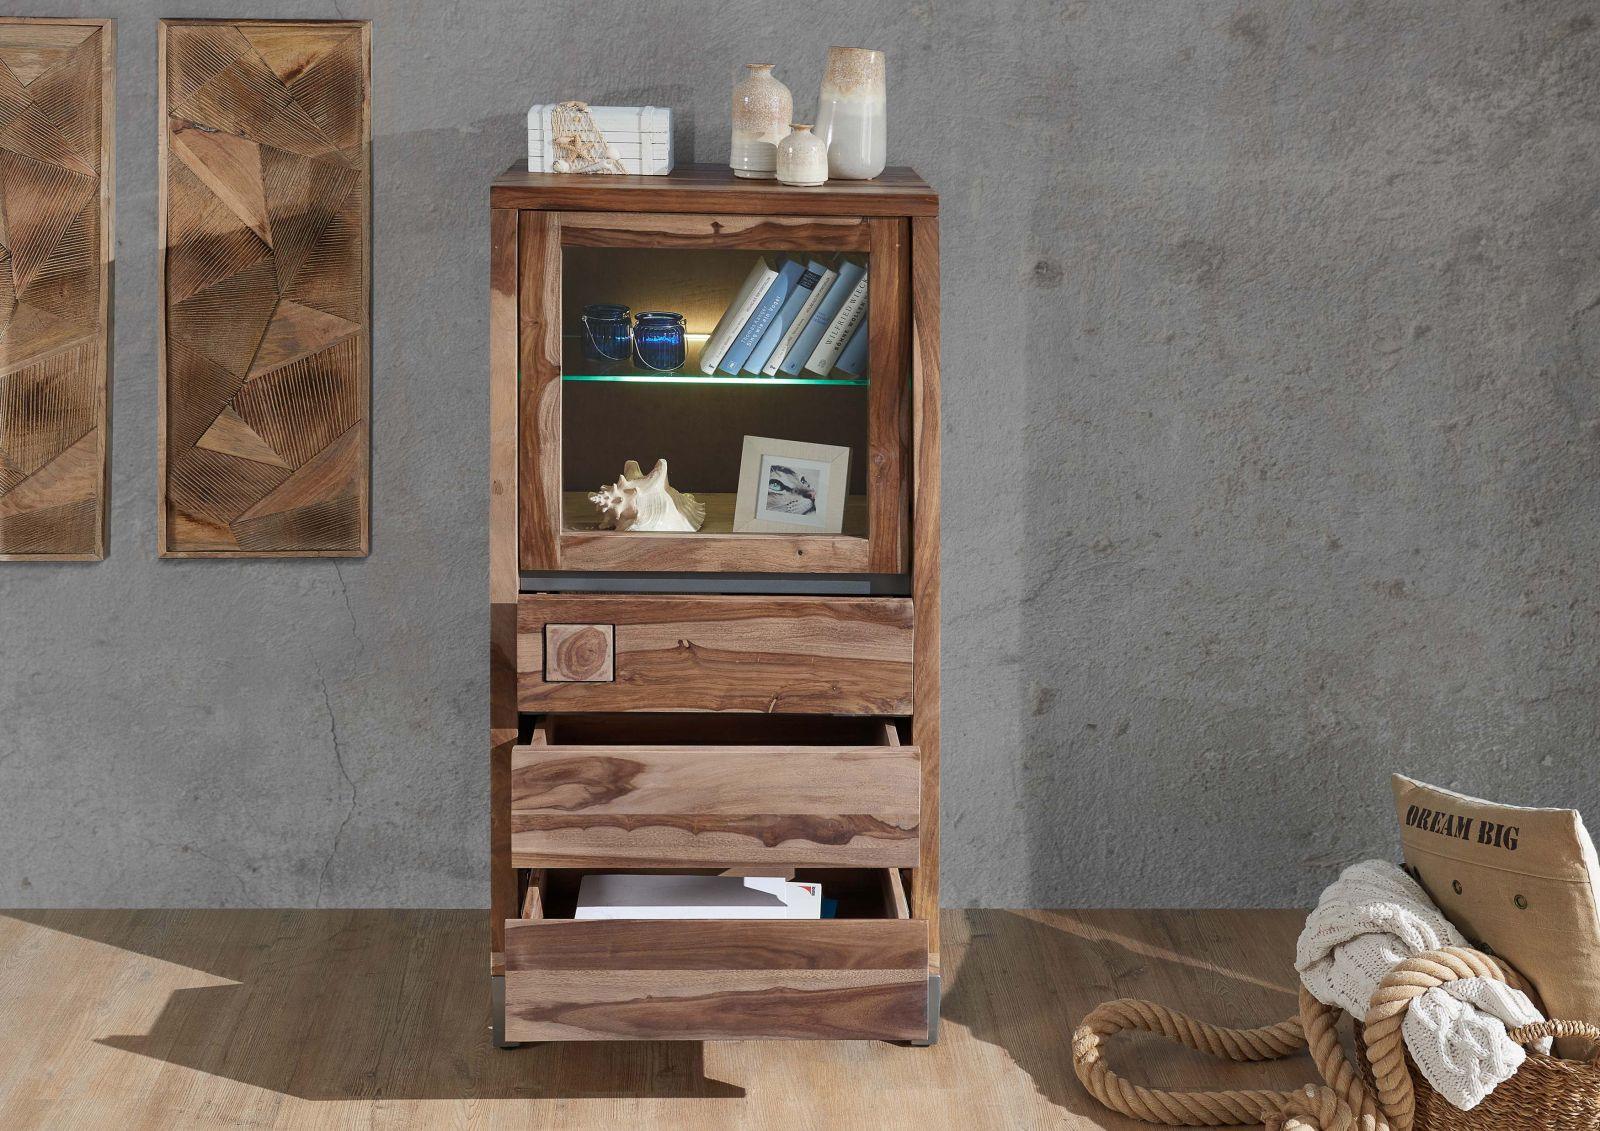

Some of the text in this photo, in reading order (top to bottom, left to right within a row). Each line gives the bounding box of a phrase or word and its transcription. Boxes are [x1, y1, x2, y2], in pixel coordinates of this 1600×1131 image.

[747, 334, 758, 346] Sing
[768, 295, 781, 311] Vogel
[825, 305, 852, 345] WILFRIED
[834, 329, 849, 351] SÖHNE
[1406, 805, 1520, 851] DREAM BIG
